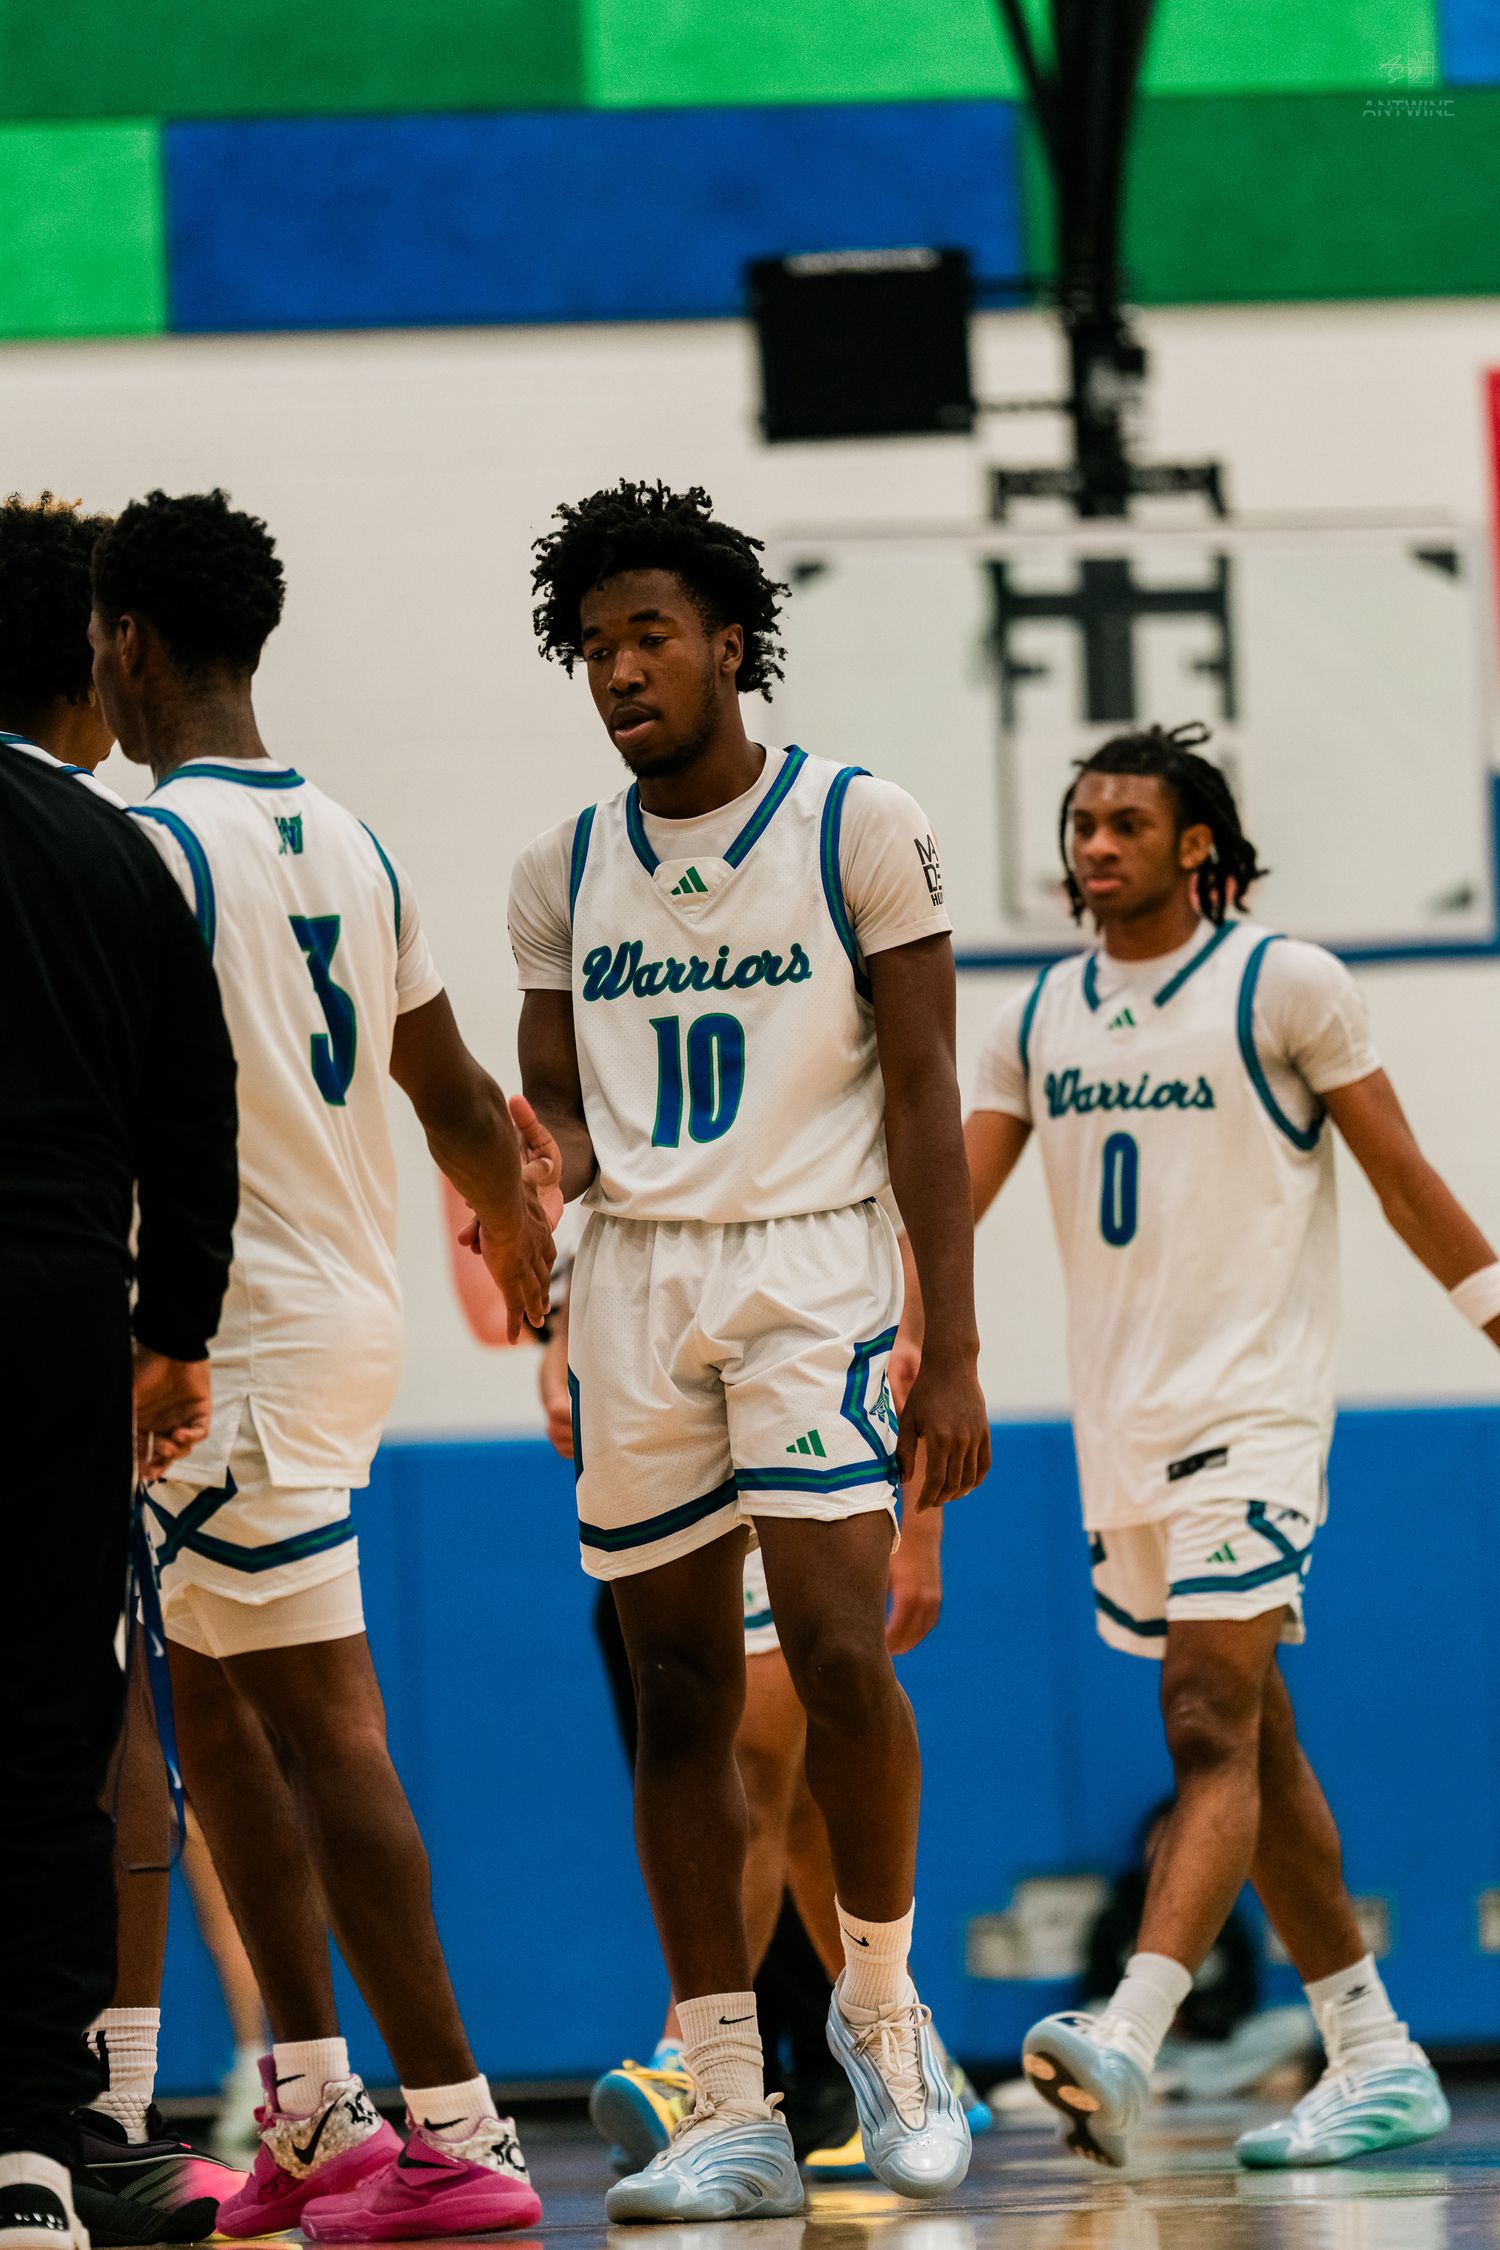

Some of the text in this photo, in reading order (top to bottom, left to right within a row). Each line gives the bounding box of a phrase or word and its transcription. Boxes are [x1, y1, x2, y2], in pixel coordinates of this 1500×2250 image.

[288, 914, 357, 1107] 3
[582, 940, 812, 1002] Warriors
[649, 1012, 745, 1149] 10
[1044, 1065, 1216, 1119] Warriors
[1100, 1131, 1138, 1248] 0
